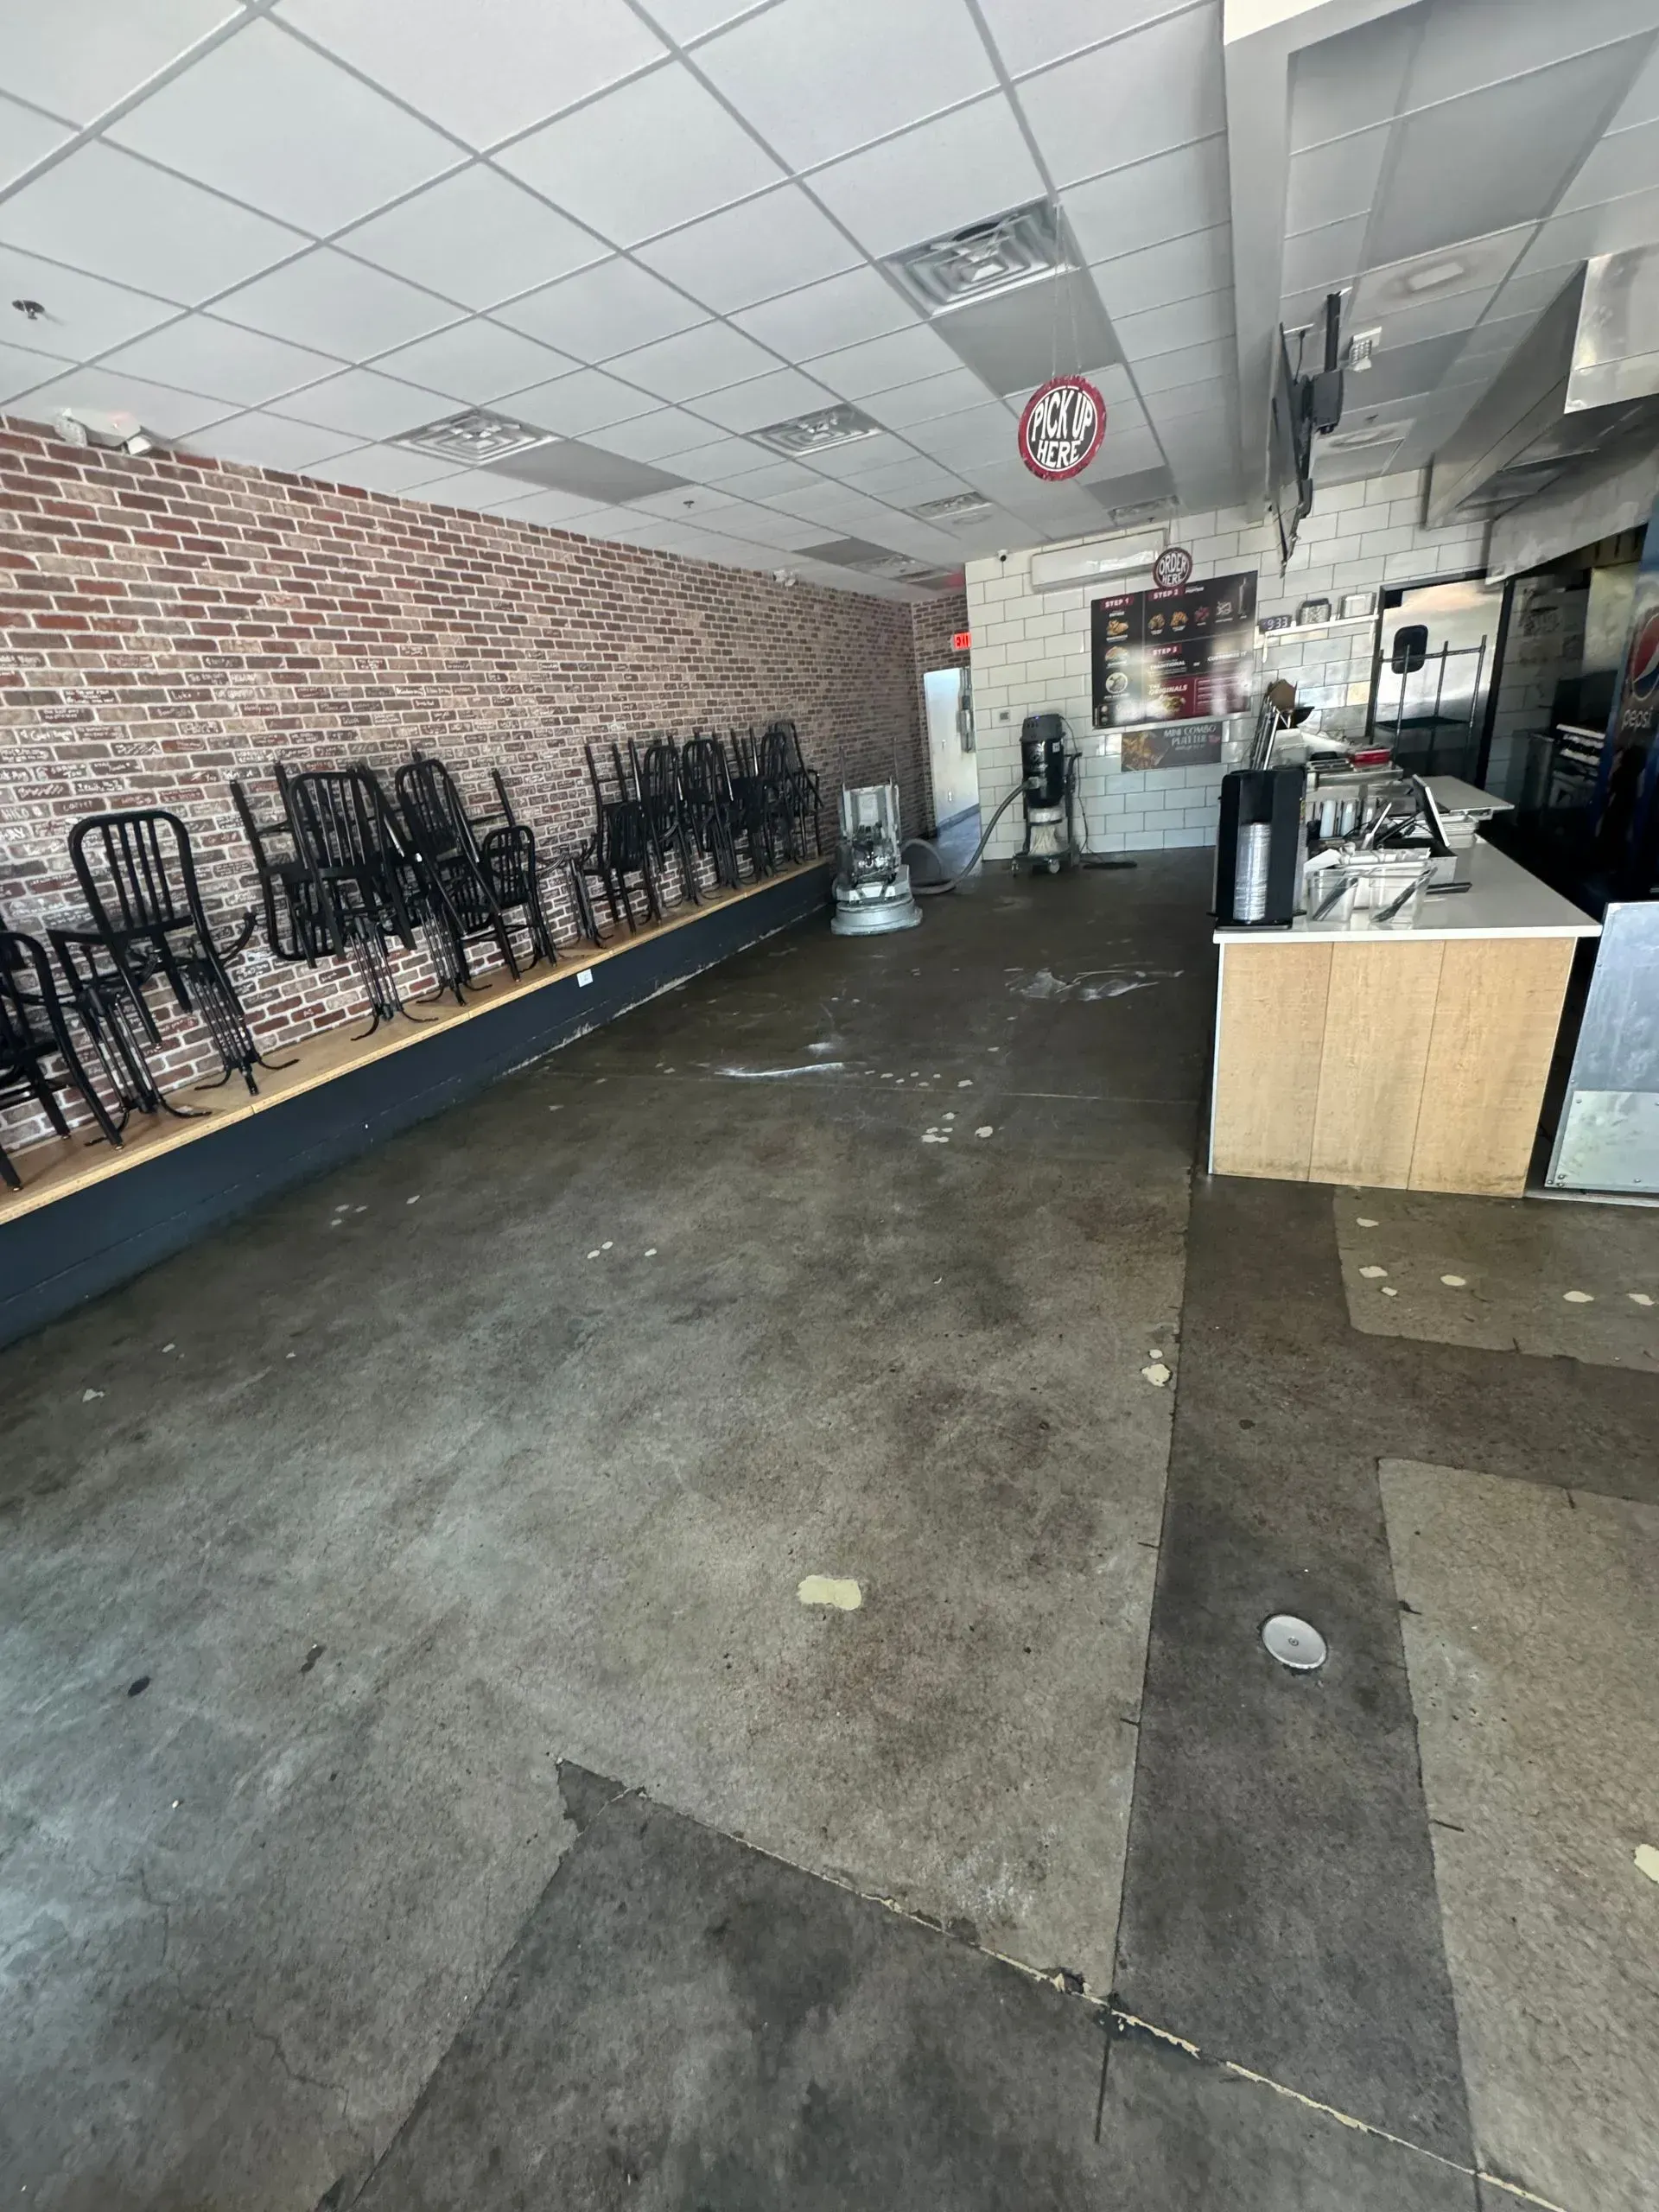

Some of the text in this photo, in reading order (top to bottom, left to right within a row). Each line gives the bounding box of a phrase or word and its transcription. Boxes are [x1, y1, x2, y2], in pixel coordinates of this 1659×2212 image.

[1031, 389, 1094, 442] PICK UP
[1037, 439, 1082, 468] HERE
[1159, 552, 1187, 575] ORDER
[1162, 572, 1185, 585] HERE
[1154, 590, 1173, 600] STEP
[1105, 599, 1123, 608] STEP
[1153, 647, 1172, 656] STEP
[1150, 660, 1186, 670] TRADITIONAL
[1148, 683, 1188, 696] ORIGINALS
[1621, 705, 1654, 732] pepsi
[1184, 724, 1217, 736] COMBO
